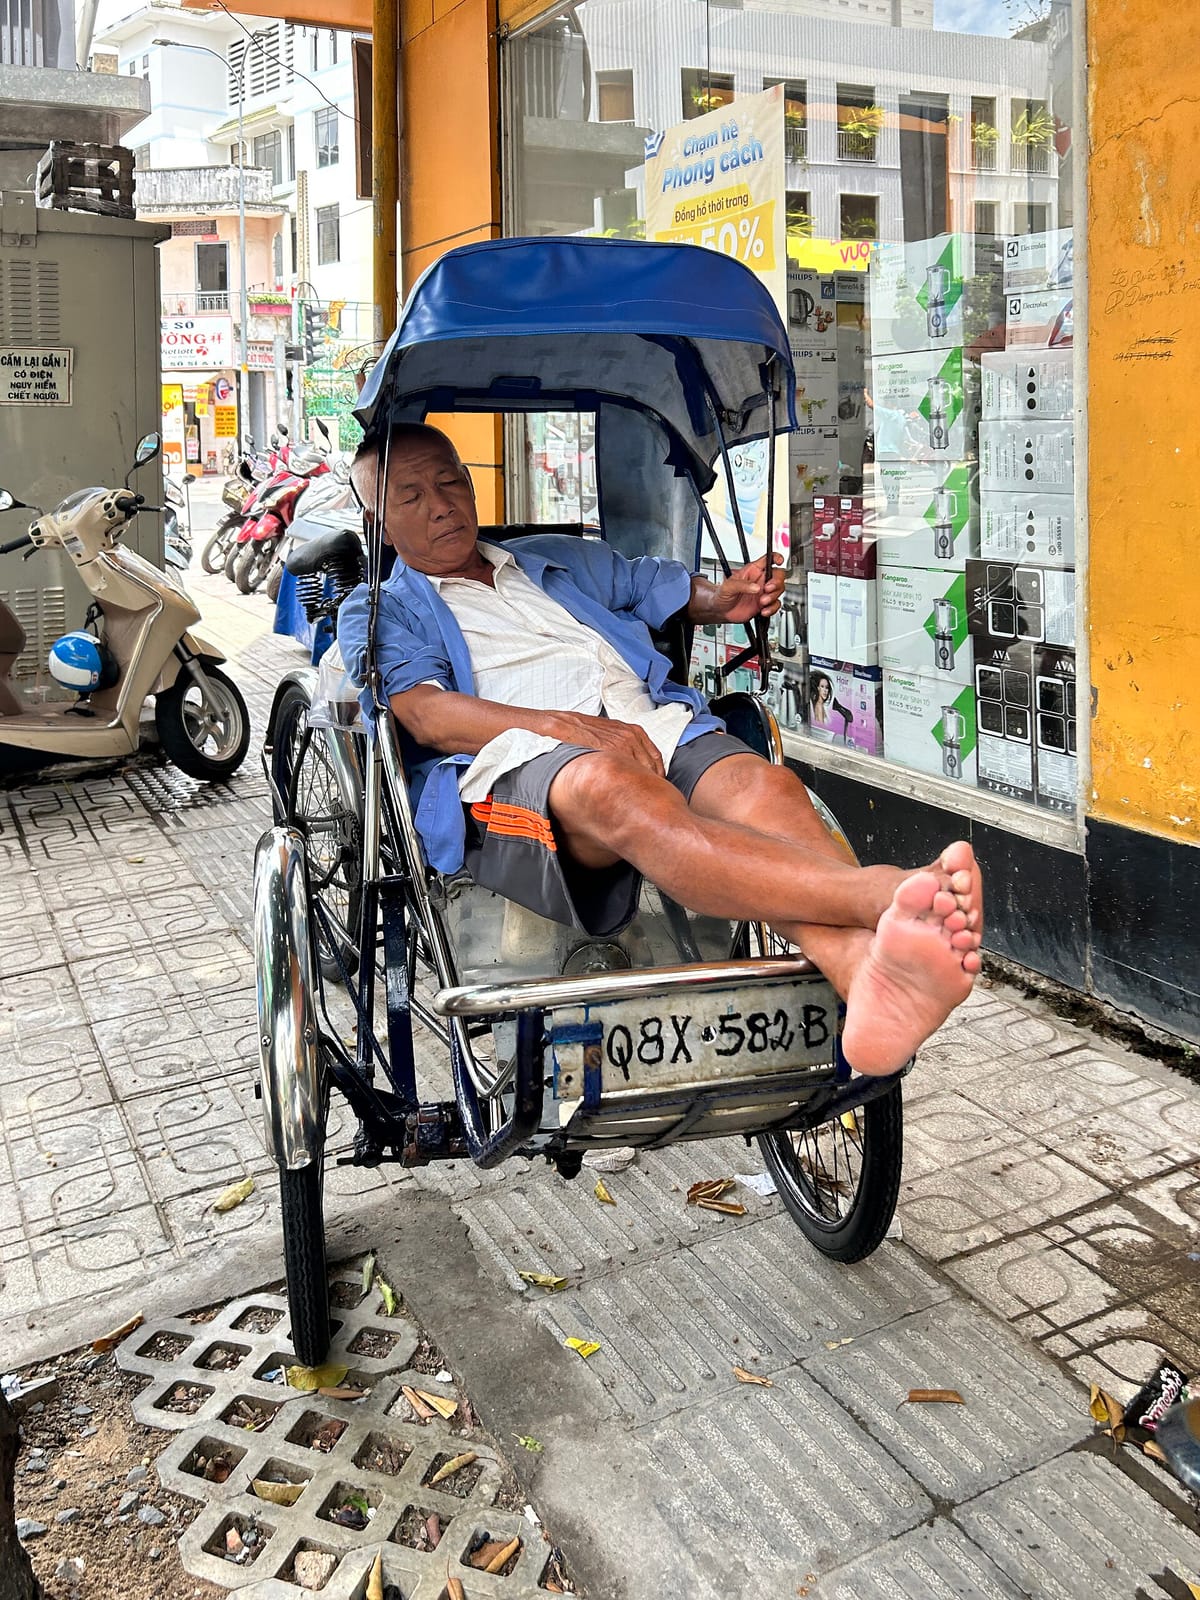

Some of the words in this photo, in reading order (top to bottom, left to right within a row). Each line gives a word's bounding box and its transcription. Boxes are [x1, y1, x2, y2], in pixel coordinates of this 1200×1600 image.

[683, 131, 718, 157] Chạm
[722, 119, 739, 142] hè
[662, 158, 715, 192] Phong
[719, 136, 764, 172] cách
[726, 194, 749, 208] trang
[24, 356, 39, 368] LẠI
[14, 370, 27, 378] CÓ
[881, 573, 908, 583] Kangaroo
[992, 649, 1011, 661] AVA
[1054, 660, 1075, 673] AVA
[888, 675, 916, 687] Kangaroo
